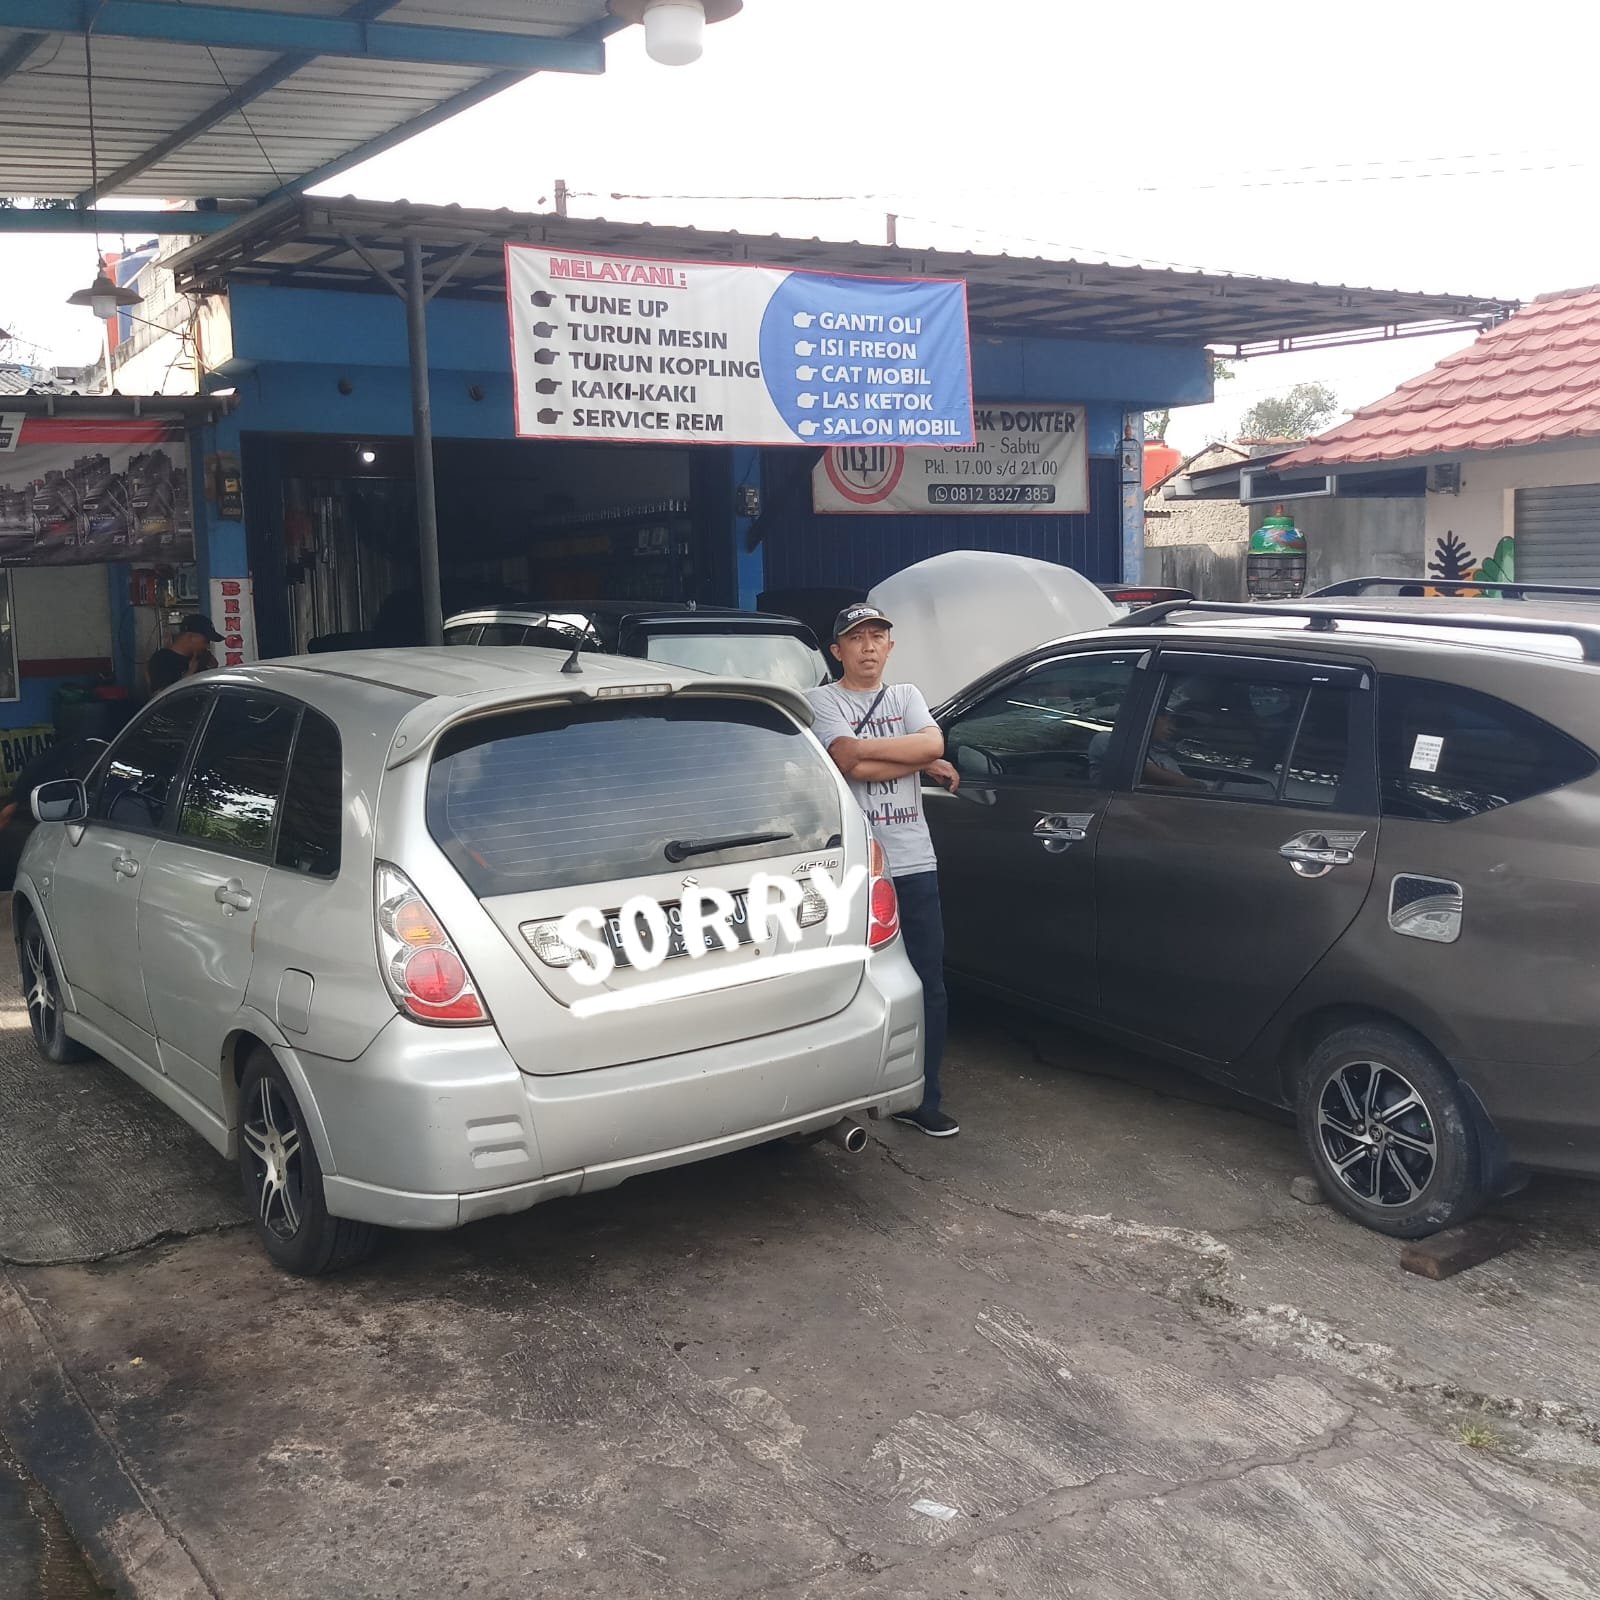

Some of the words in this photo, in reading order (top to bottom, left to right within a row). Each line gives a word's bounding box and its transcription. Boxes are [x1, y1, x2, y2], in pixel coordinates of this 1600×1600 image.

[550, 258, 674, 285] MELAYANI
[565, 294, 632, 316] TUNE
[639, 300, 669, 318] UP
[819, 312, 884, 332] GANTI
[888, 316, 921, 334] OLI
[568, 322, 651, 345] TURUN
[658, 329, 728, 350] MESIN
[820, 338, 843, 357] ISI
[849, 340, 917, 360] FREON
[569, 351, 652, 373] TURUN
[659, 357, 760, 379] KOPLING
[821, 365, 862, 383] CAT
[866, 367, 931, 385] MOBIL
[572, 380, 696, 403] KAKI-KAKI
[822, 391, 859, 410] LAS
[865, 393, 933, 411] KETOK
[572, 408, 669, 430] SERVICE
[676, 413, 723, 431] REM
[823, 417, 893, 436] SALON
[898, 419, 961, 436] MOBIL
[1002, 411, 1075, 433] DOKTER
[1000, 437, 1040, 454] Sabtu
[925, 459, 948, 475] Pkl.
[955, 460, 991, 475] 17.00
[996, 460, 1016, 475] s/d
[1021, 461, 1057, 476] 21.00
[951, 487, 984, 501] 0812
[989, 487, 1019, 501] 8327
[1024, 487, 1049, 501] 385
